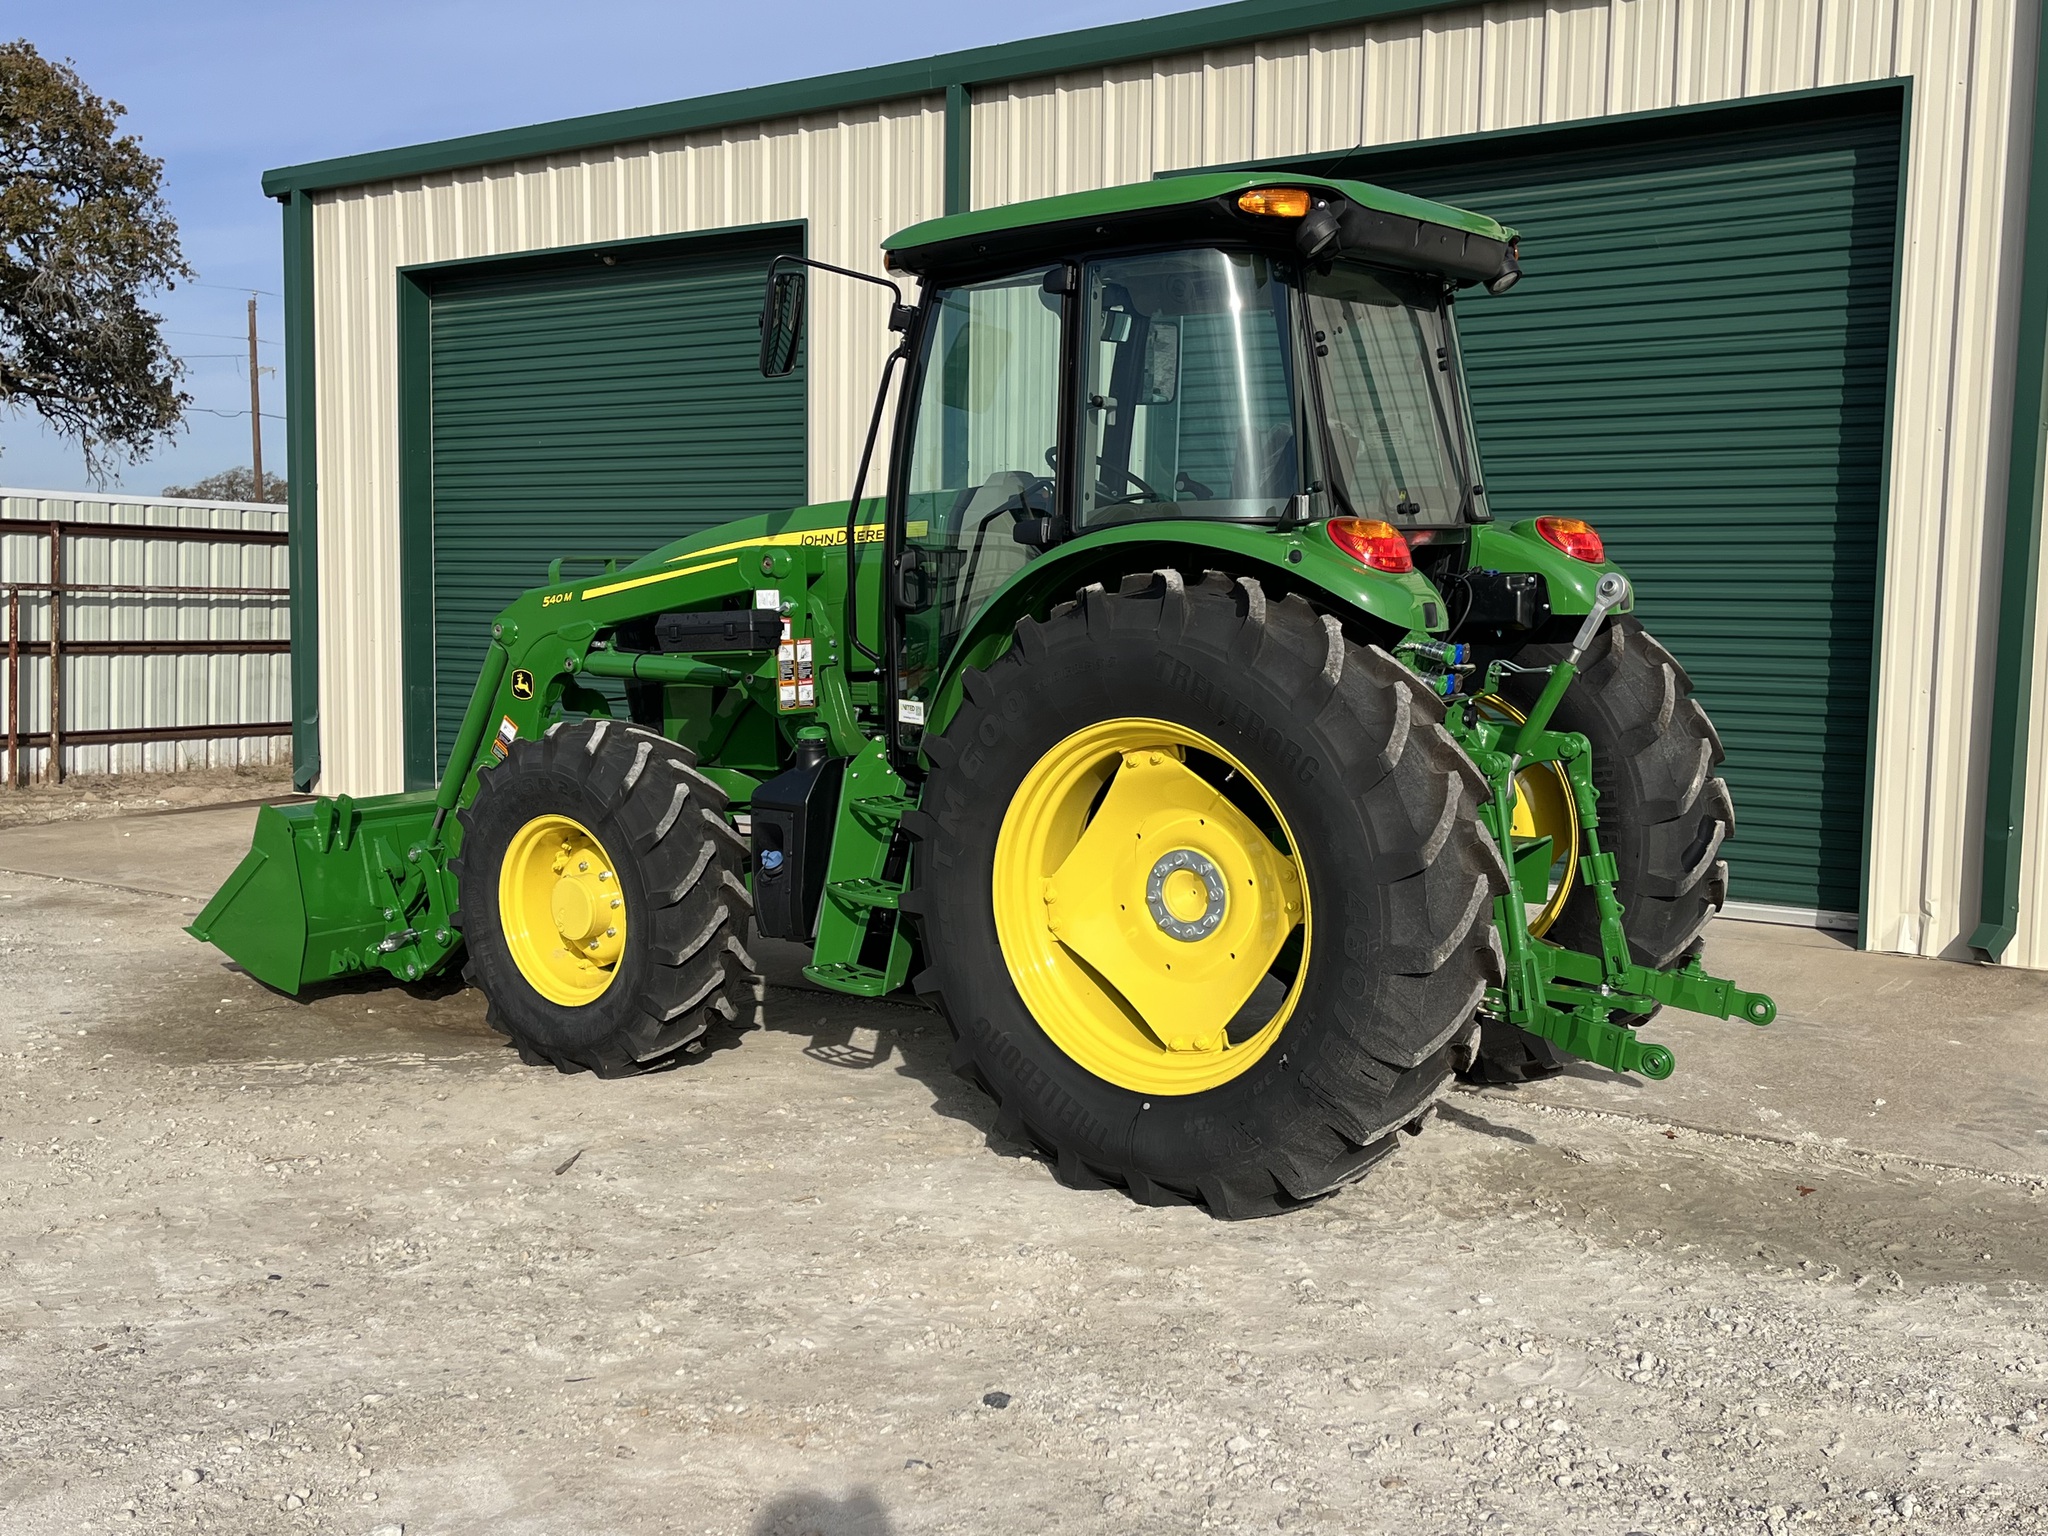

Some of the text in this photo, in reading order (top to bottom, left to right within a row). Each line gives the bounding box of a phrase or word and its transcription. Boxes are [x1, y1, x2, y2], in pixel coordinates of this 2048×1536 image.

[800, 533, 834, 546] JOHN
[1154, 649, 1321, 787] TRELLEBORG
[971, 1016, 1109, 1151] TRELLEBORG
